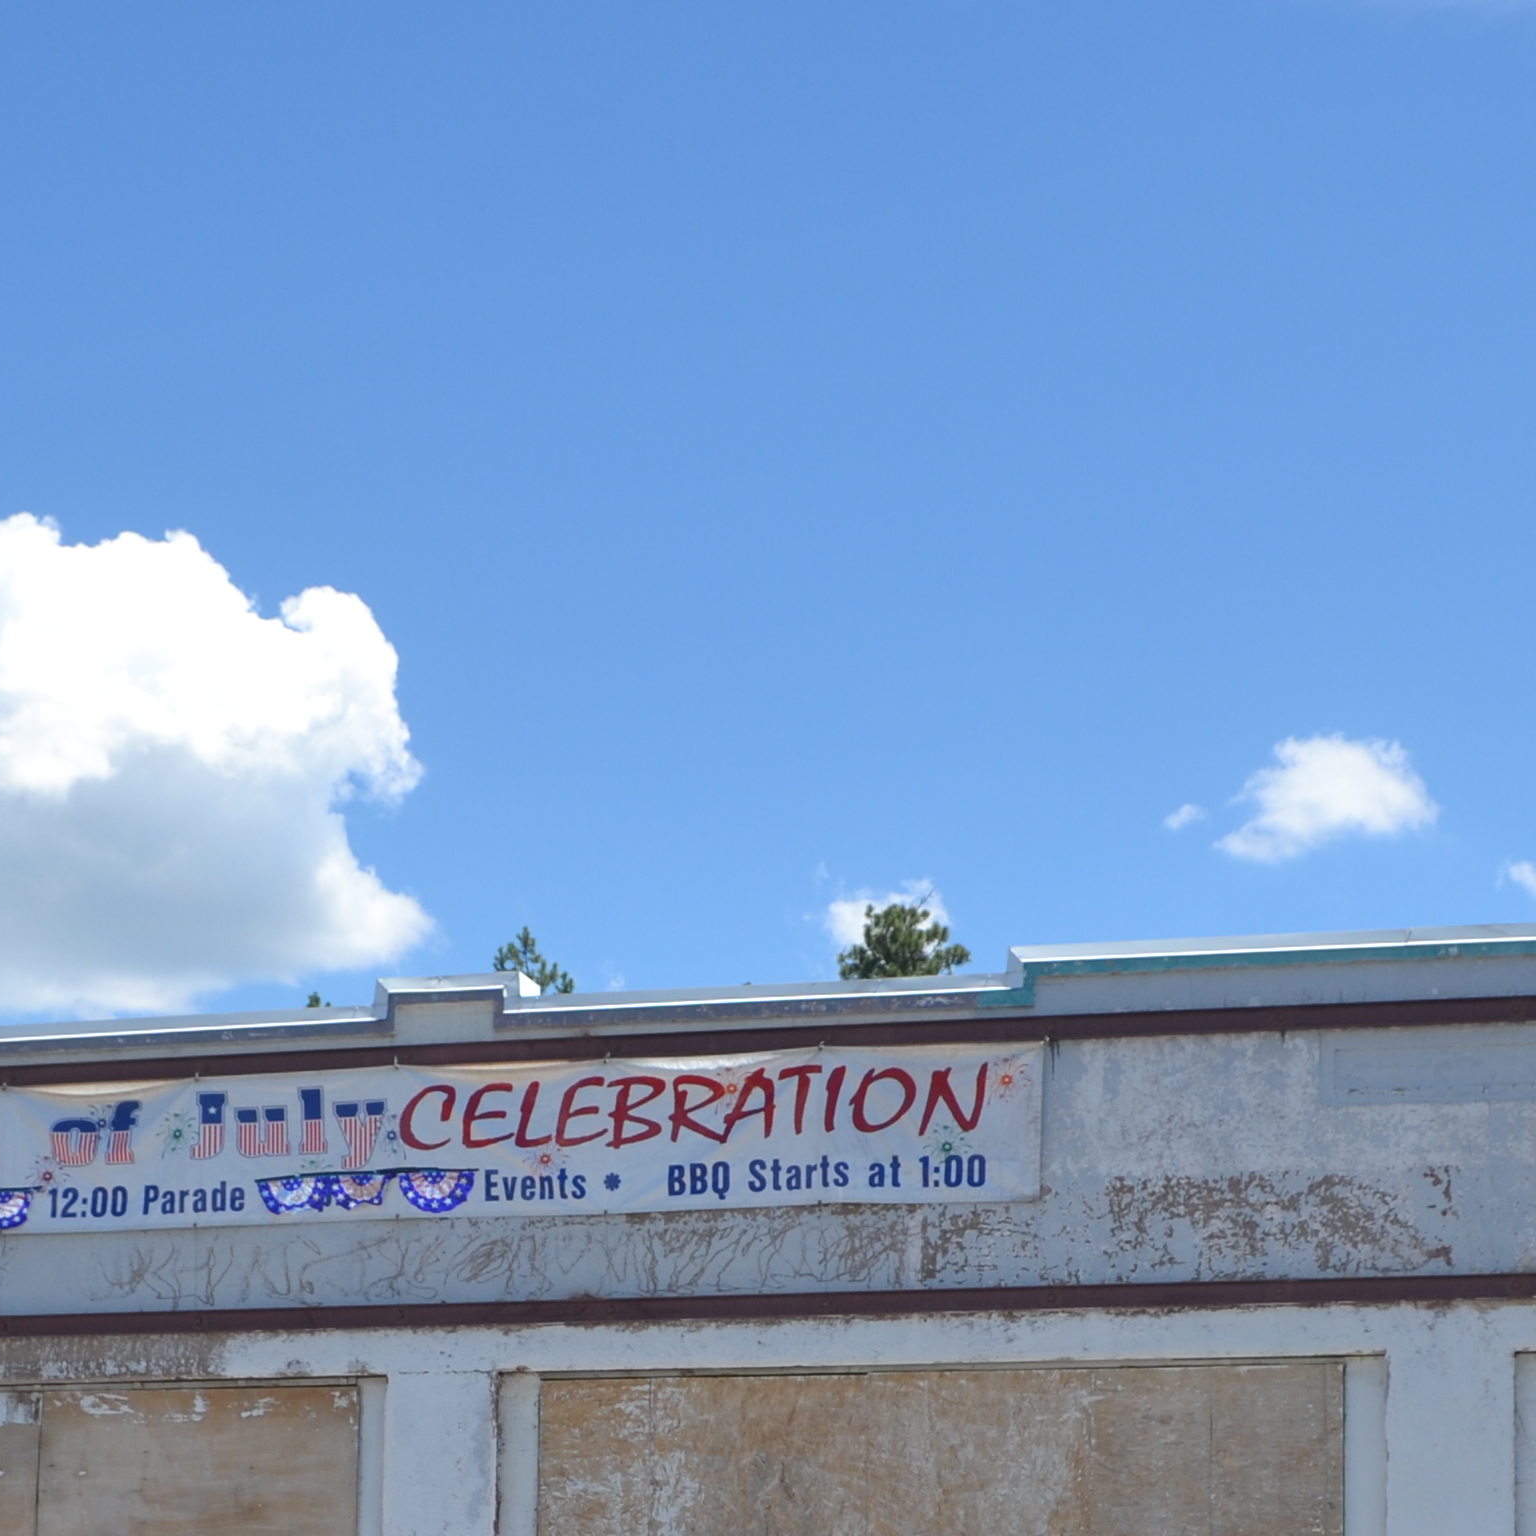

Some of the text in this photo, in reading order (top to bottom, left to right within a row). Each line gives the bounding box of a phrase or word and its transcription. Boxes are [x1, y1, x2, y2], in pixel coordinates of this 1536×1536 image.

[50, 1100, 143, 1168] of
[190, 1086, 387, 1170] July
[399, 1062, 989, 1150] CELEBRATION
[49, 1154, 986, 1219] 12:00 Parade Events BBQ Starts at 1:00
